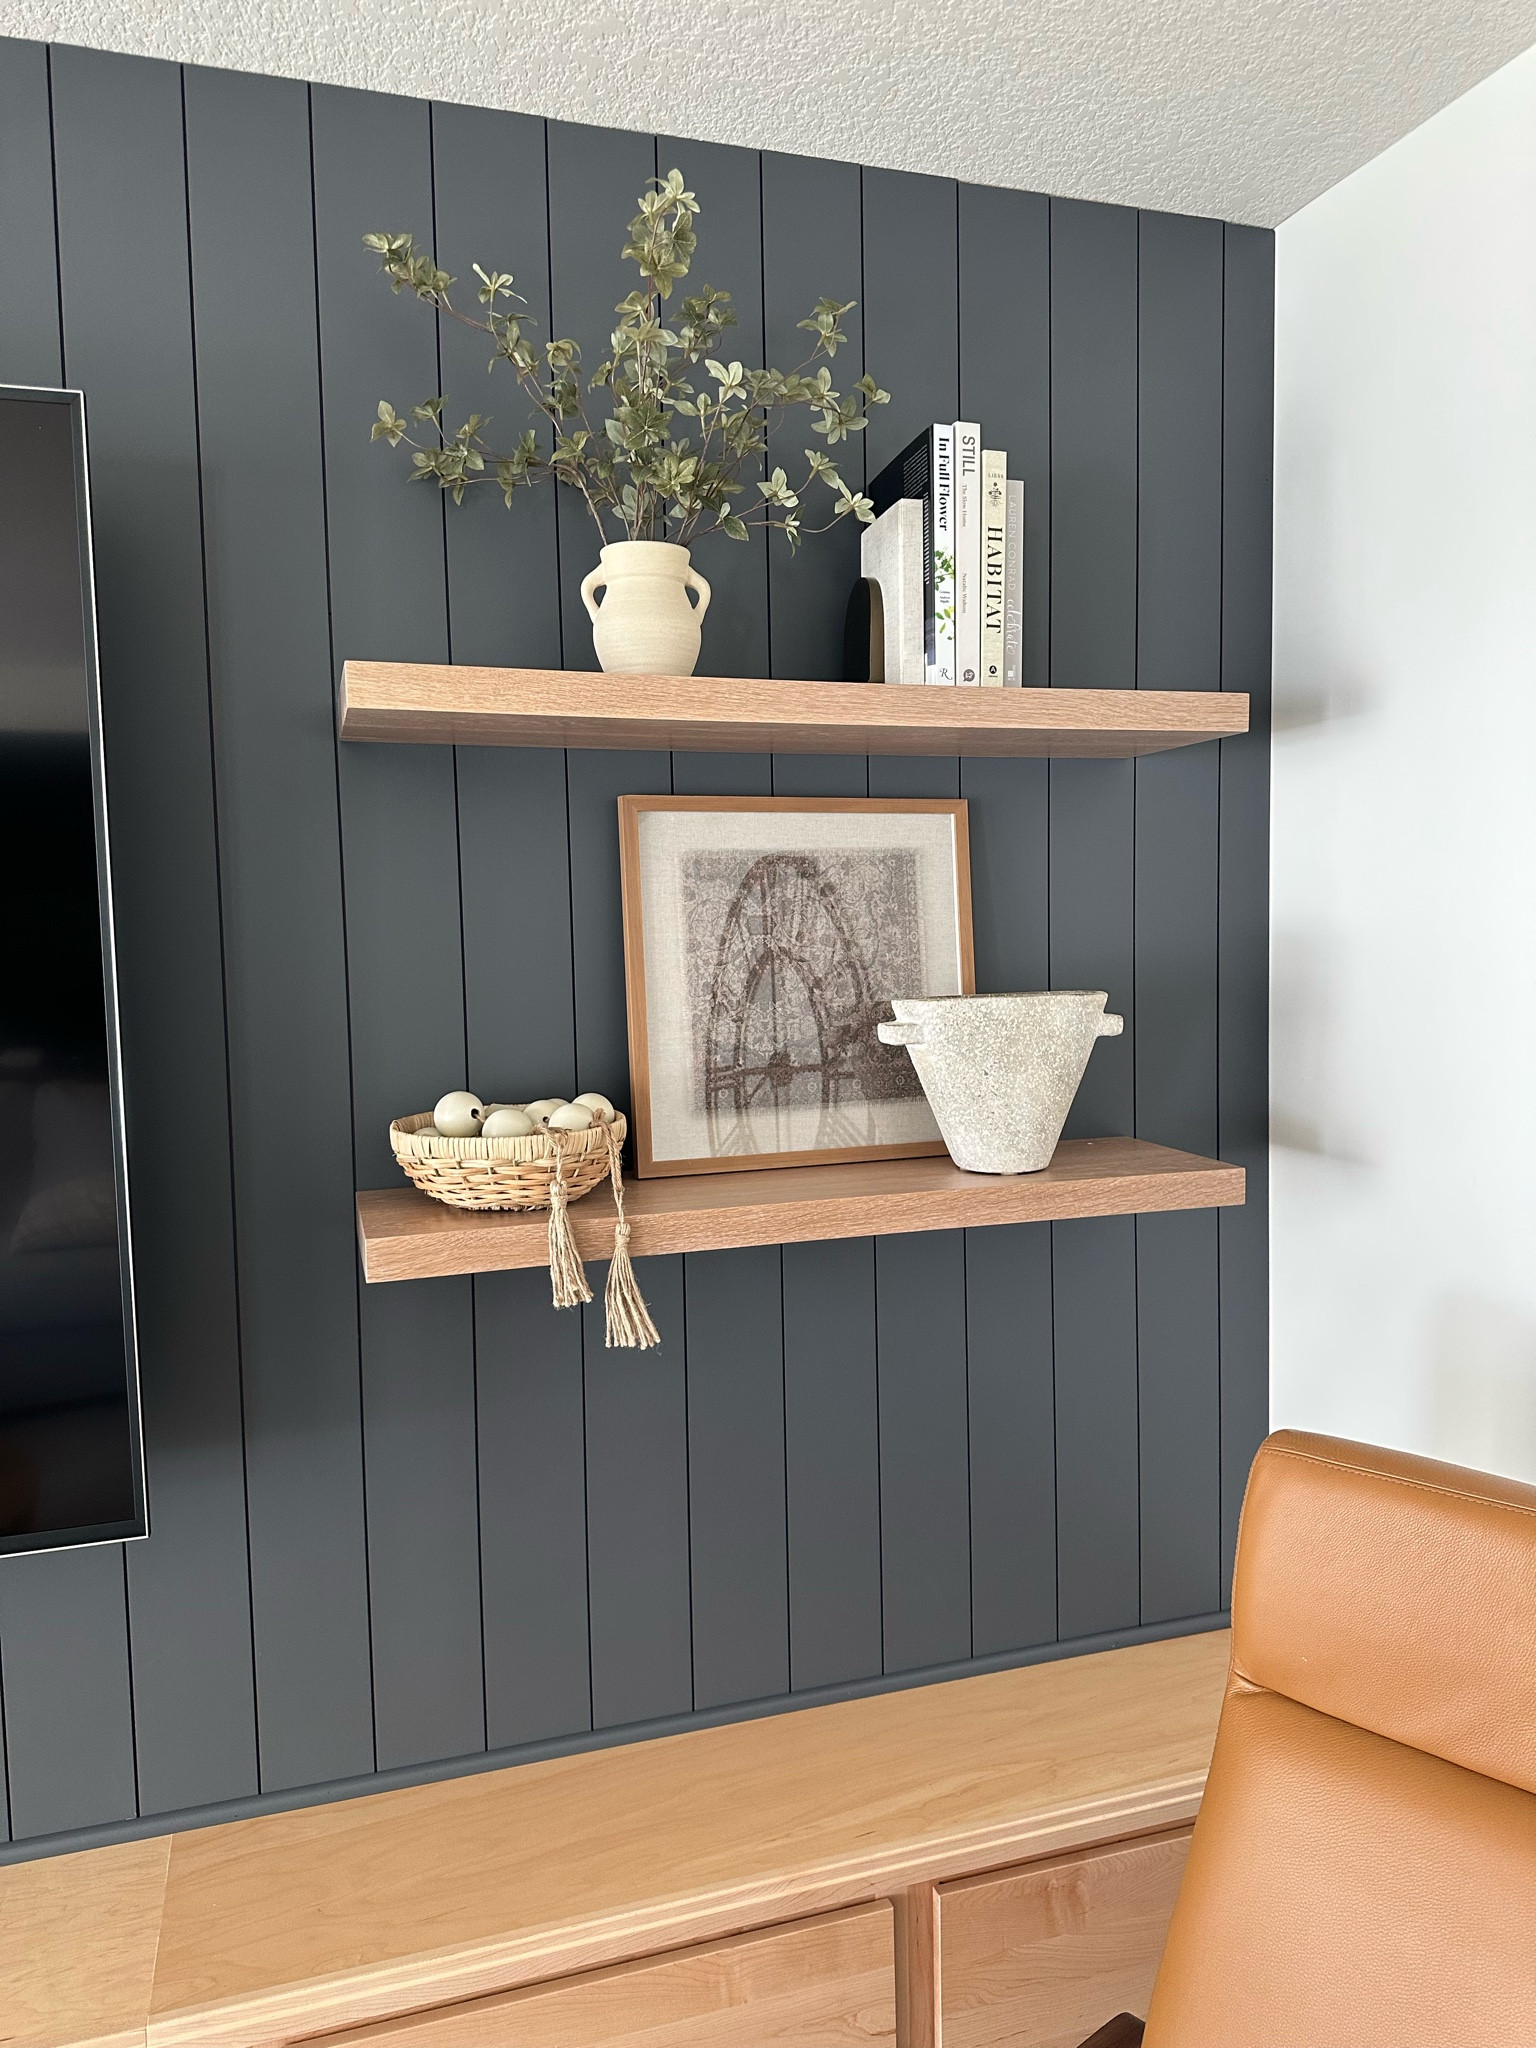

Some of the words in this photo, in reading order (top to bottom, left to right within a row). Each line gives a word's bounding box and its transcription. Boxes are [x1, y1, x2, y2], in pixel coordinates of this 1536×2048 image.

[938, 438, 950, 451] In
[962, 435, 975, 477] STILL
[938, 455, 950, 480] Full
[939, 484, 950, 531] Flower
[1008, 495, 1017, 538] LAUREN
[986, 526, 1003, 634] HABITAT
[1007, 543, 1017, 591] CONRAD
[1006, 599, 1021, 655] celebrate
